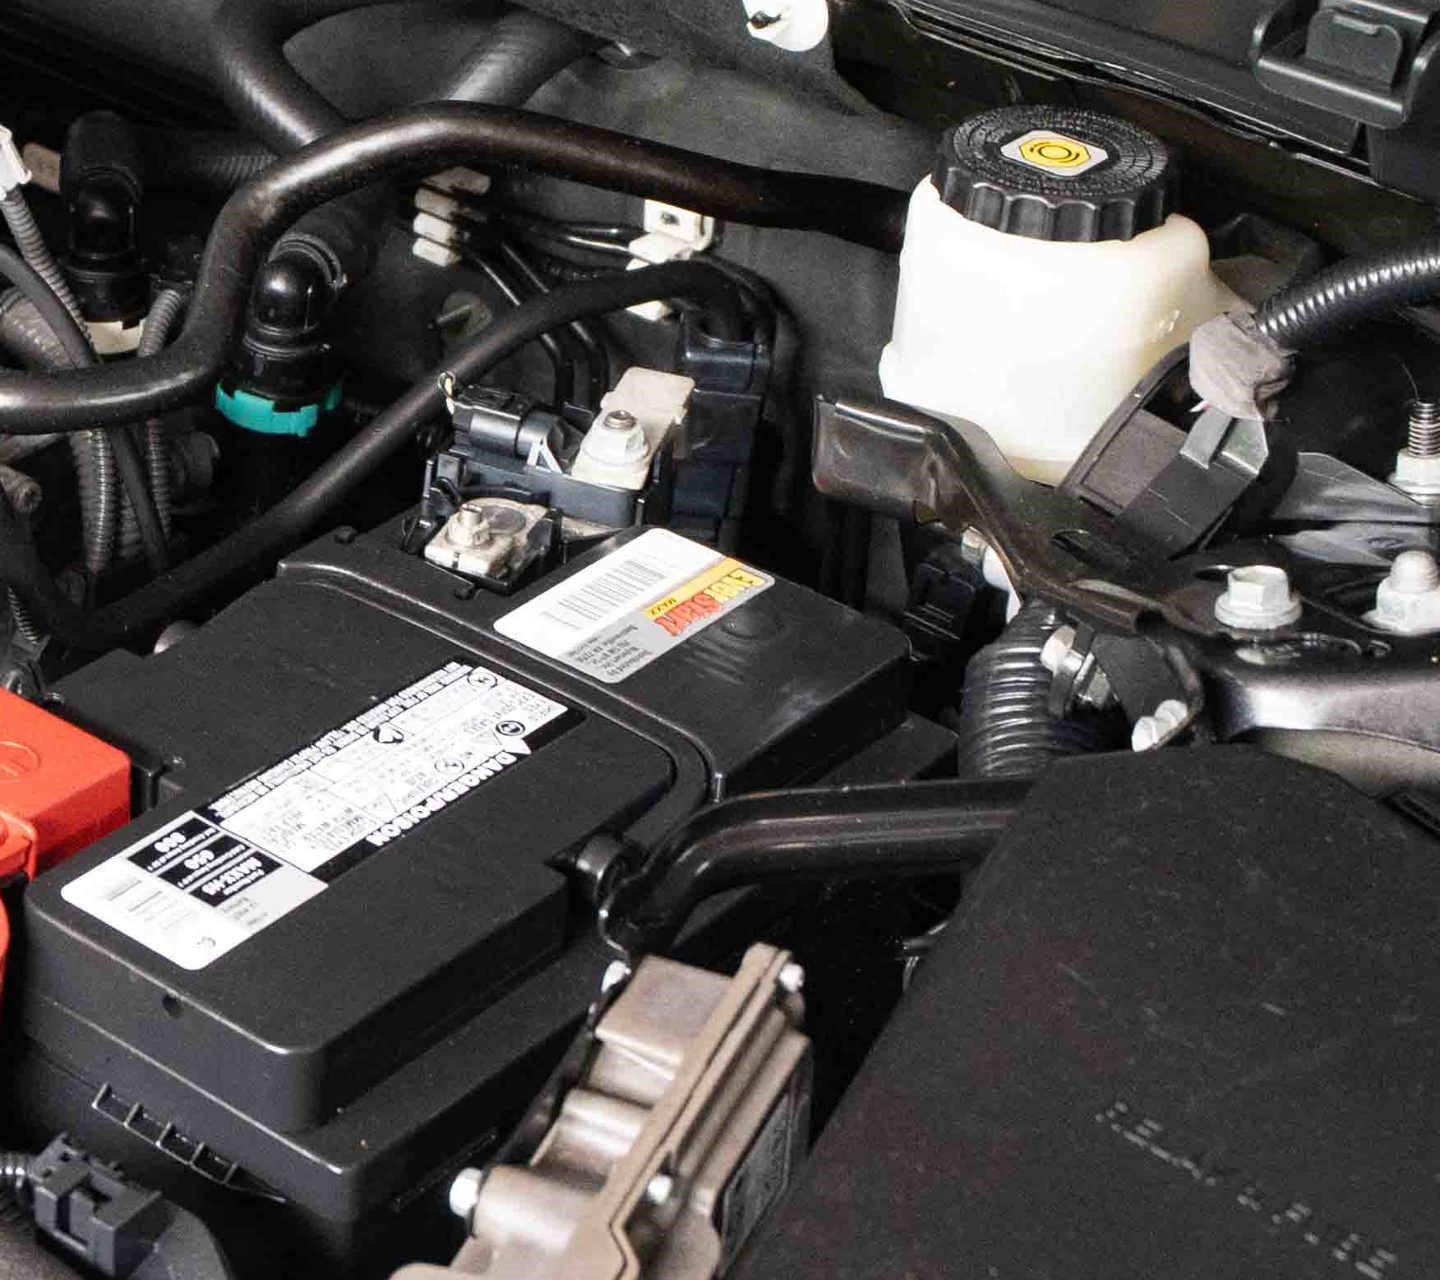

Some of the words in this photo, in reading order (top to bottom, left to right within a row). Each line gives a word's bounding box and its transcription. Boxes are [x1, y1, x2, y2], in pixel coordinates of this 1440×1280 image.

[652, 568, 768, 637] EverStart
[366, 750, 517, 847] DANGER/POISON
[183, 850, 216, 870] 650
